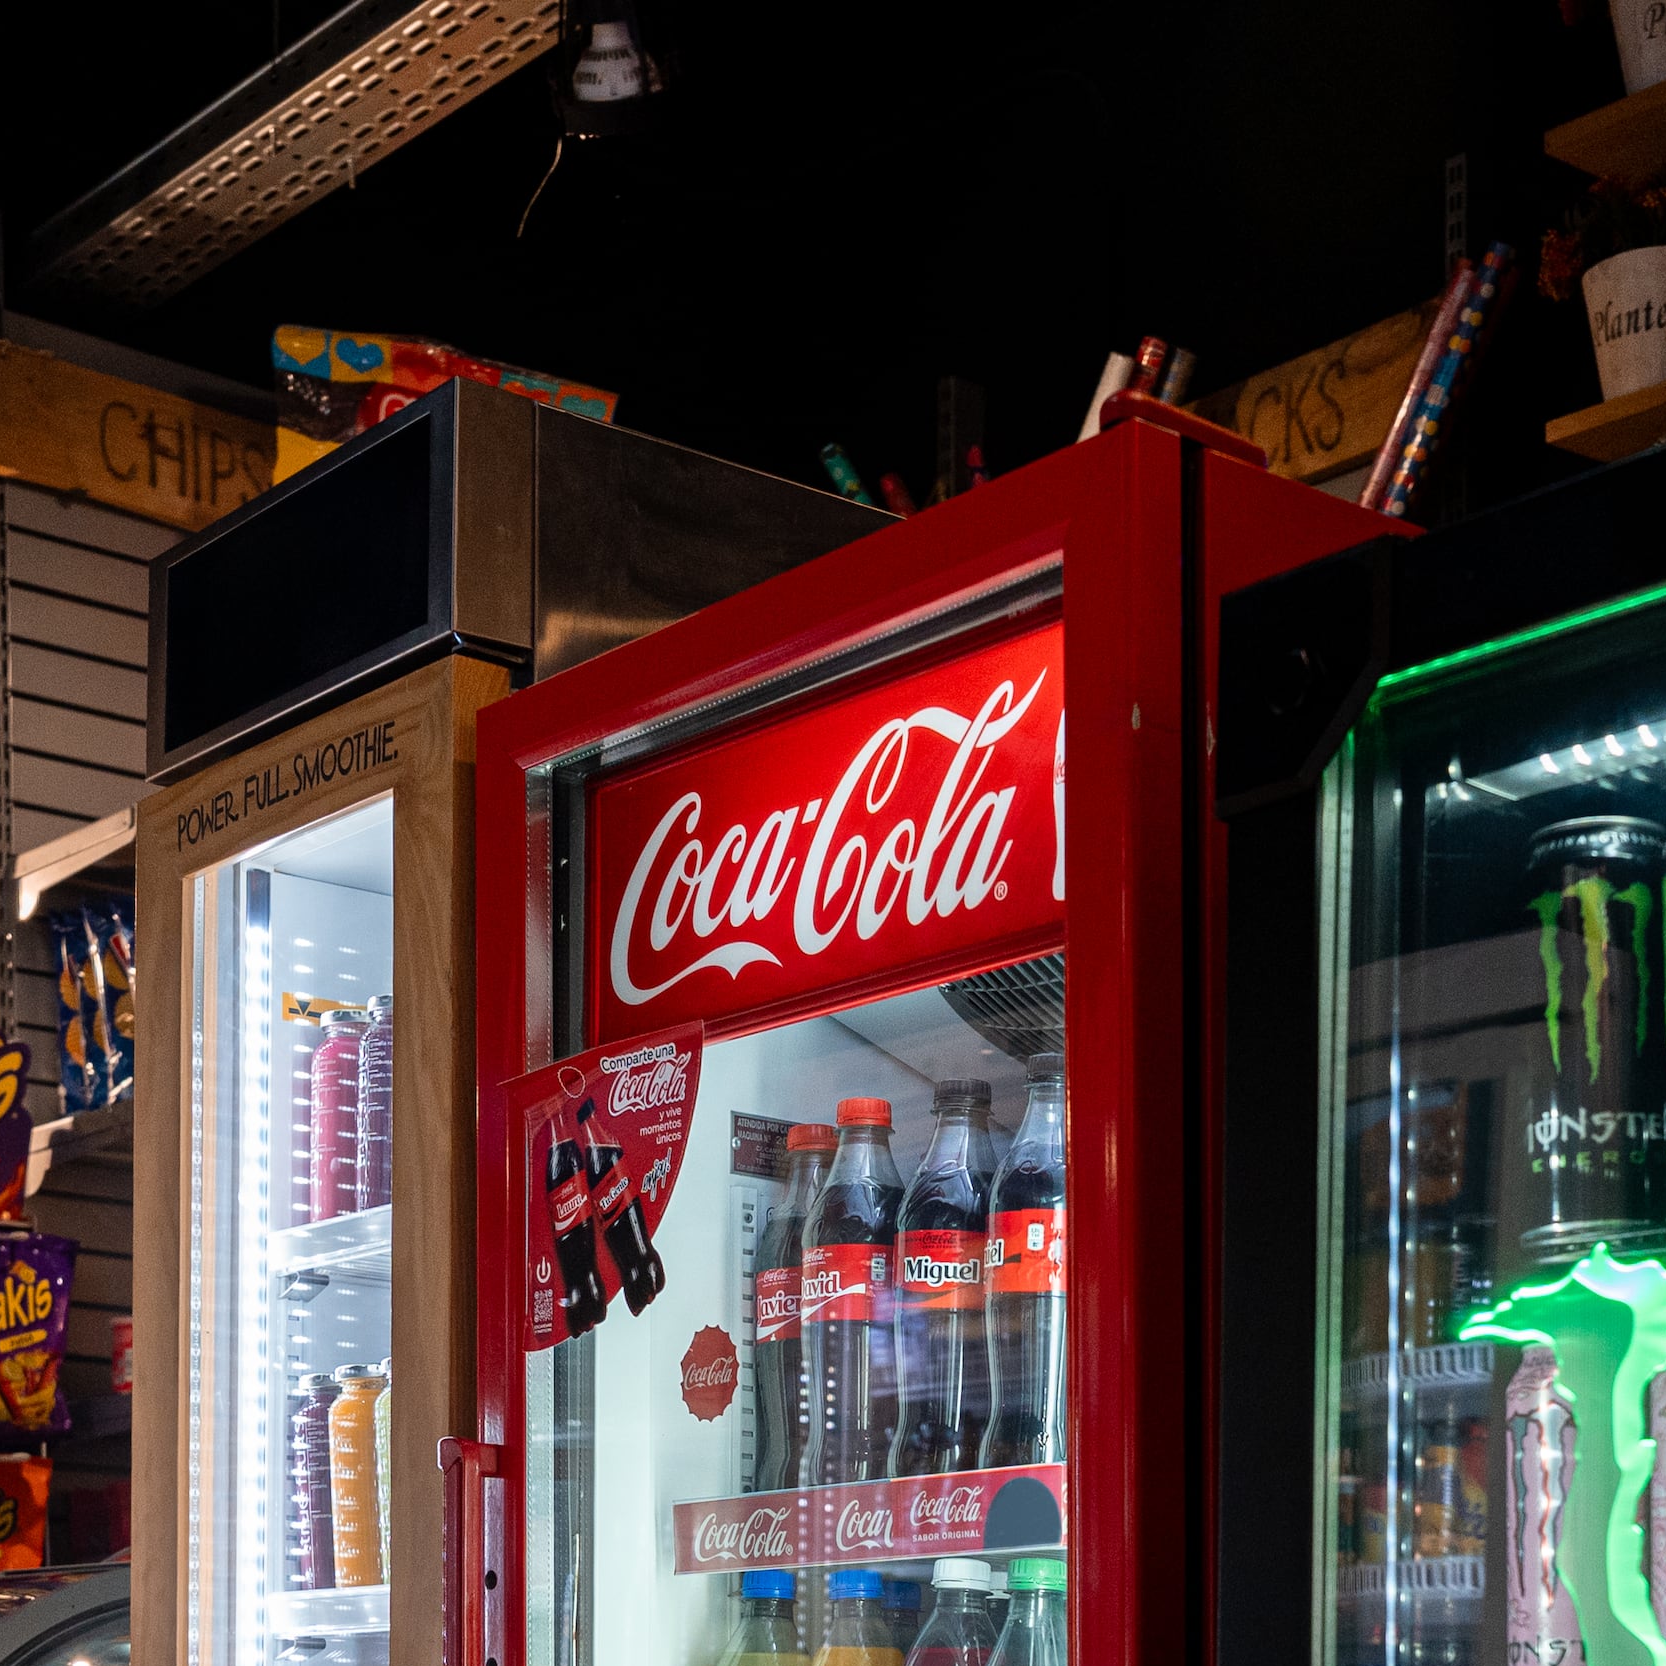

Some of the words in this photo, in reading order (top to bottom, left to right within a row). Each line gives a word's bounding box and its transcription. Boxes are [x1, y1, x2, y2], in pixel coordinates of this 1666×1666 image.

[100, 402, 273, 507] CHIPS
[610, 667, 1047, 1005] Coca-Cola
[600, 1055, 652, 1074] Comparte
[653, 1045, 675, 1062] una
[608, 1052, 691, 1116] Coca-Cola
[639, 1120, 682, 1138] momentos
[659, 1110, 667, 1119] y
[669, 1106, 682, 1118] vive
[656, 1131, 682, 1145] únicos
[903, 1255, 982, 1290] Miguel
[684, 1356, 735, 1391] Coca-Cola
[909, 1485, 984, 1528] Coca-Cola
[694, 1507, 793, 1563] Coca-Cola
[912, 1532, 939, 1543] SABOR
[941, 1529, 981, 1541] ORIGINAL
